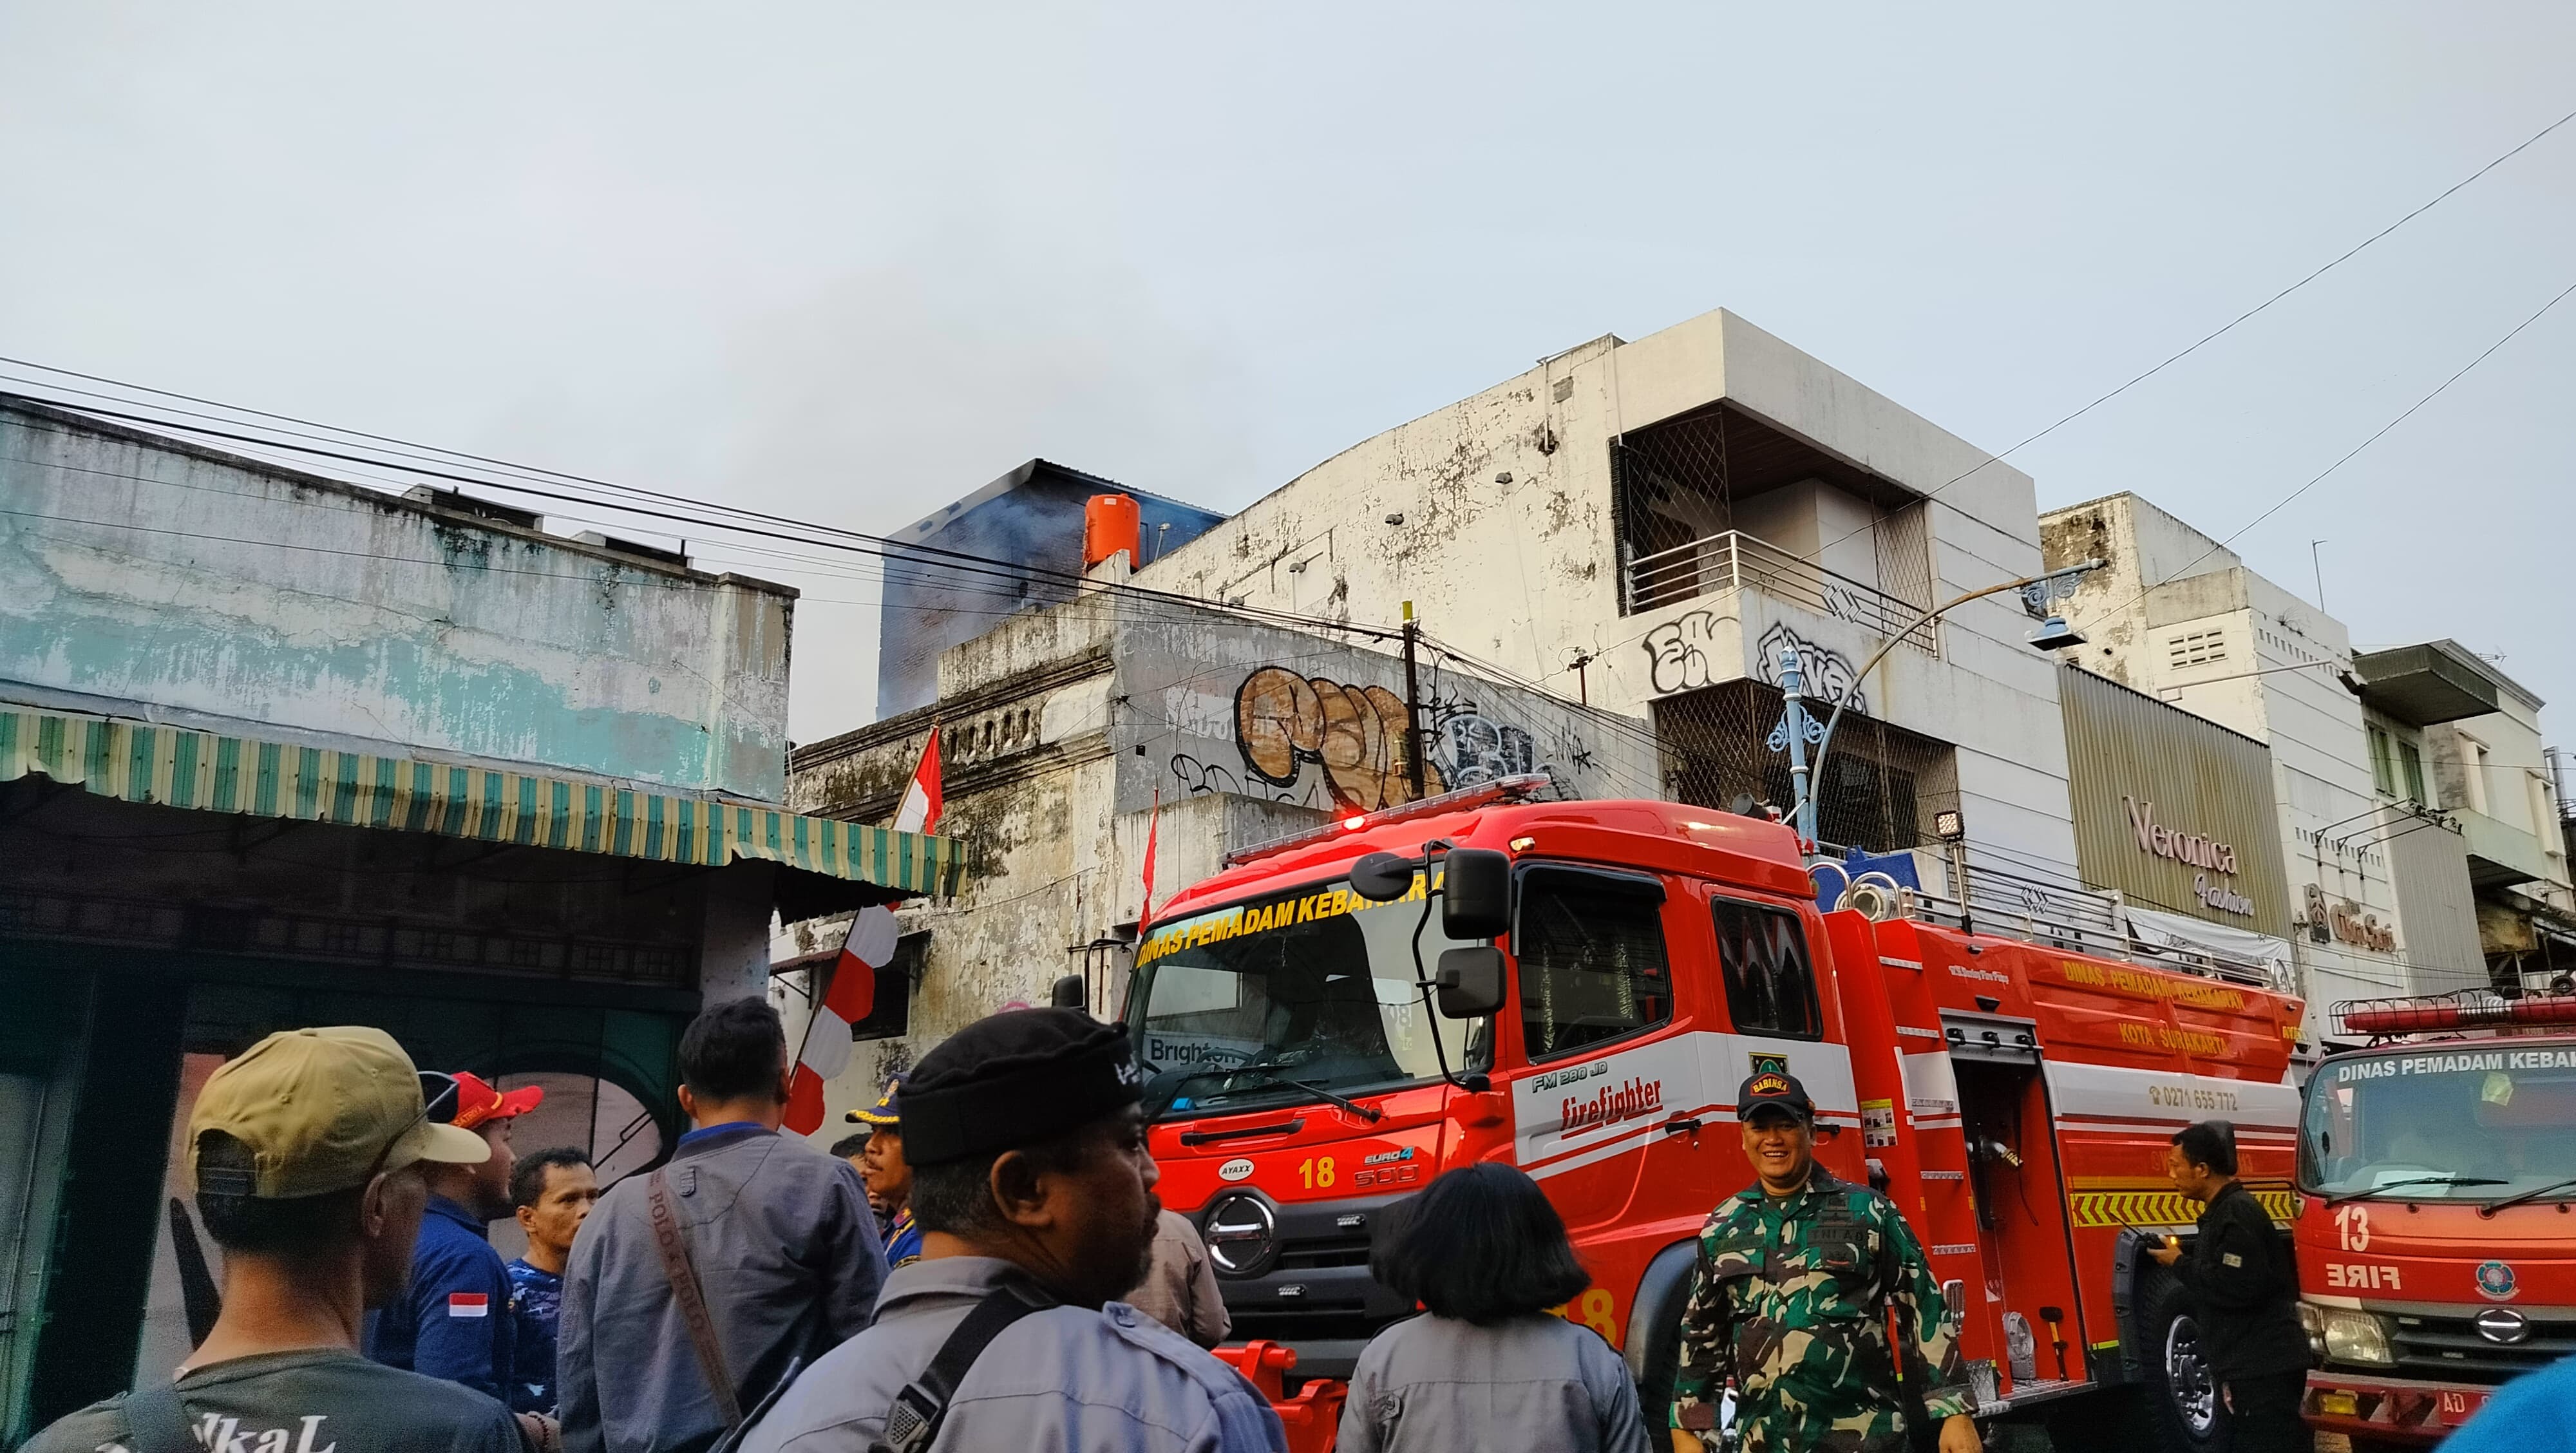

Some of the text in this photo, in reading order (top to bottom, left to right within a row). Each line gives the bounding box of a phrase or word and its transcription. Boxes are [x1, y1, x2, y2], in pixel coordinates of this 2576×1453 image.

[2123, 795, 2238, 874] Veronica
[2194, 873, 2254, 916] Fashion
[1137, 930, 1184, 969] DINAS
[1186, 900, 1295, 949] PEMADAM
[2063, 961, 2246, 1011] DINAS PEMADAM KEBAKARAN
[2119, 1023, 2228, 1056] KOTA SURAKARTA
[1532, 1061, 1607, 1093] FM 280 JD
[2339, 1060, 2396, 1082] DINAS
[2401, 1053, 2503, 1075] PEMADAM
[1752, 1078, 1788, 1093] BABINSA
[2164, 1087, 2238, 1112] 0271 655 772
[1560, 1077, 1662, 1131] firefighter
[1220, 1164, 1252, 1175] AYAXX
[1299, 1157, 1335, 1190] 18
[1354, 1164, 1419, 1189] 500
[649, 1191, 675, 1247] POLO
[2335, 1206, 2369, 1251] 13
[1844, 1231, 1863, 1242] AD
[2444, 1392, 2465, 1412] AD
